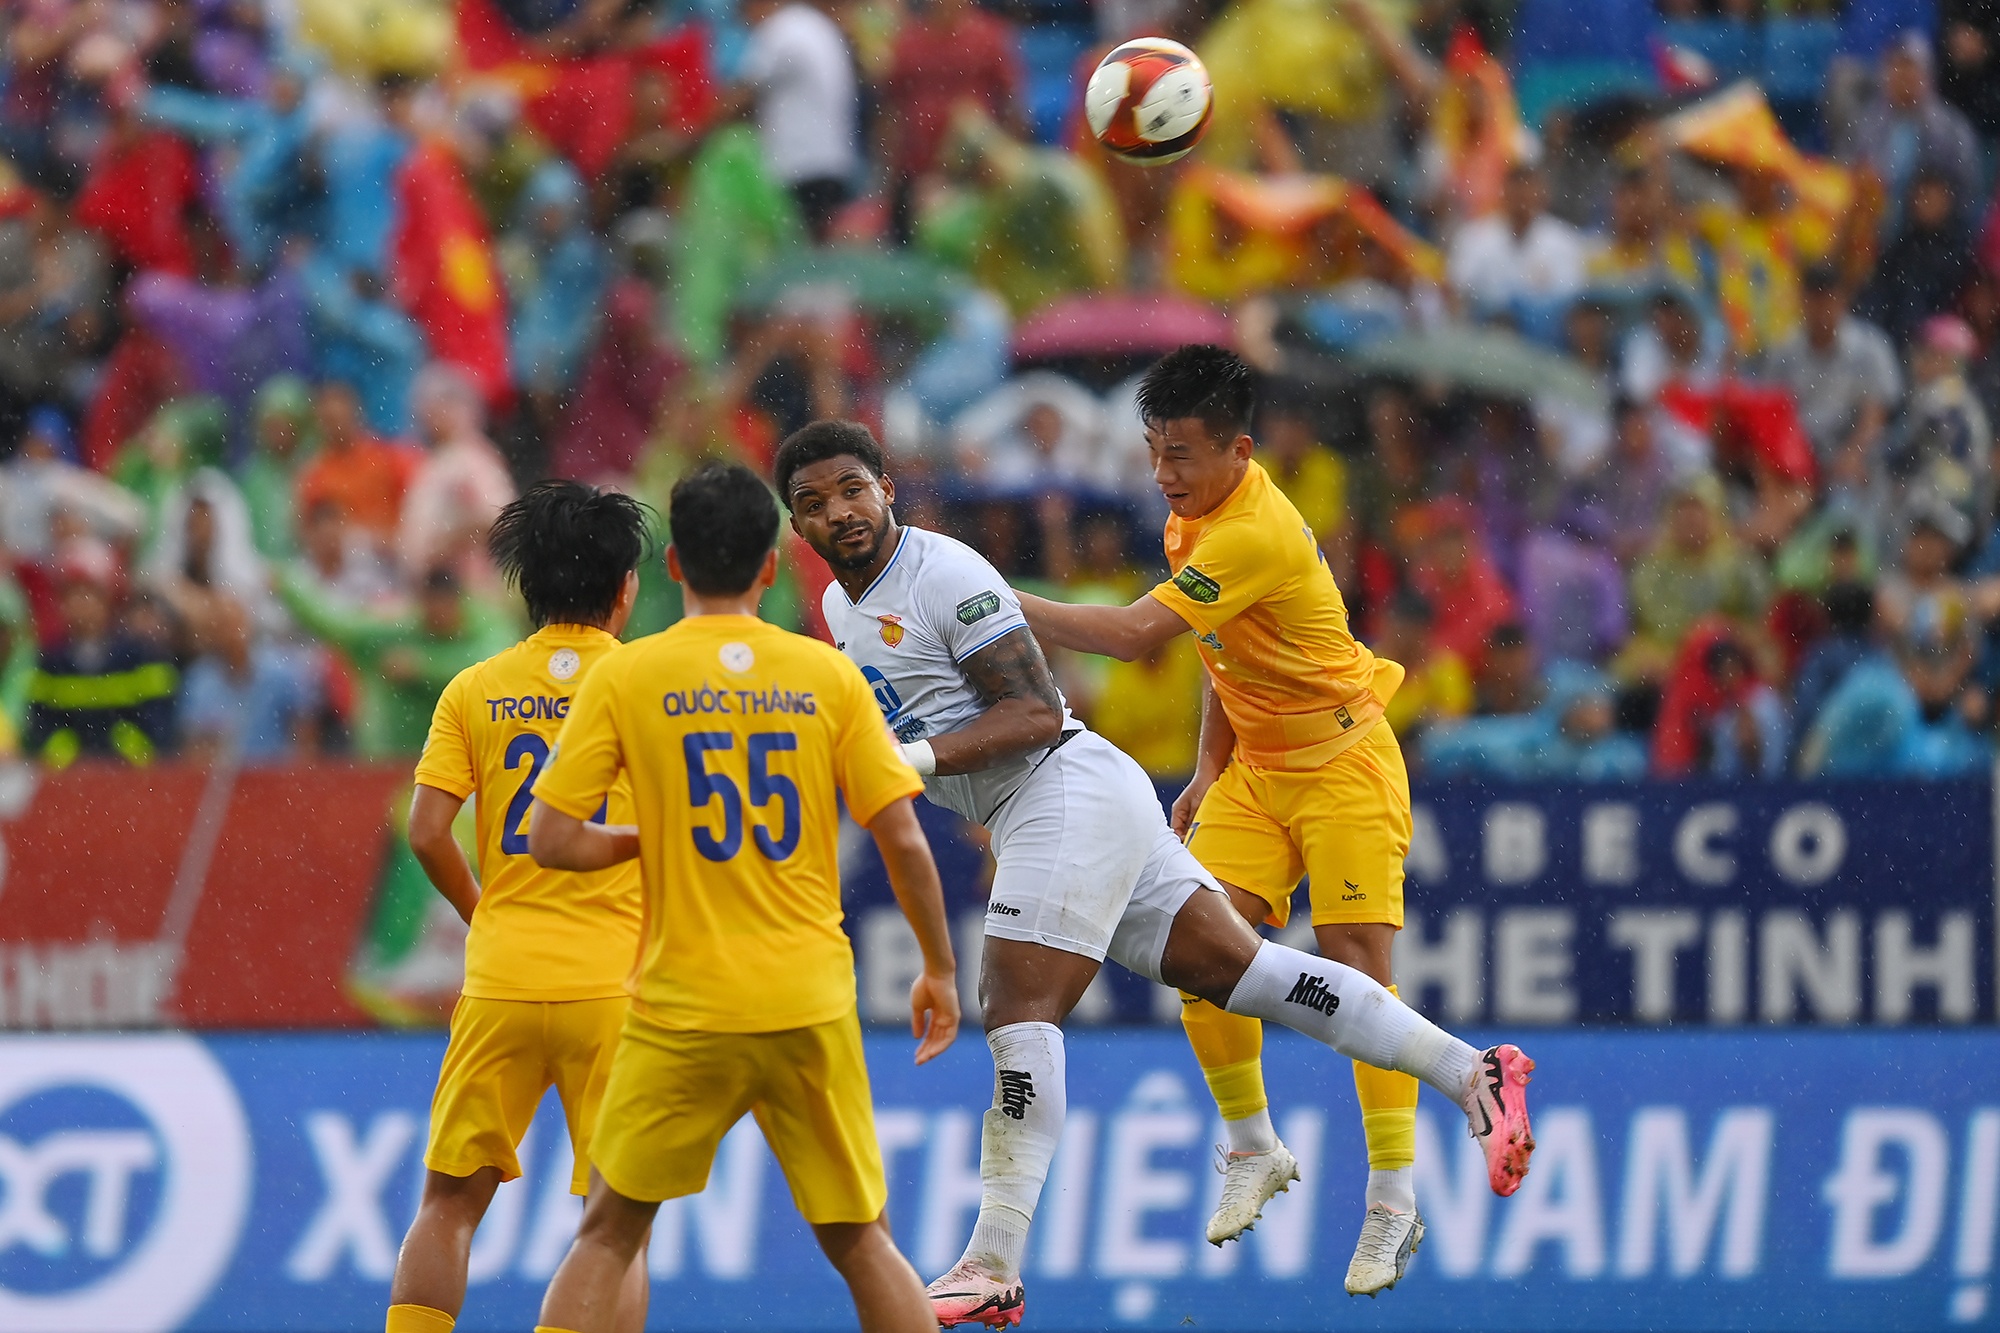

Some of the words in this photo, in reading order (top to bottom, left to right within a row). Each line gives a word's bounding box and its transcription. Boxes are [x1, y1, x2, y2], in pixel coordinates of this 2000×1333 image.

[960, 604, 981, 621] NIGHT
[980, 597, 999, 611] WOLF
[482, 695, 570, 724] TRỌNG
[682, 731, 801, 862] 55
[988, 902, 1021, 917] Mitre
[1608, 910, 1976, 1026] TINH
[1284, 971, 1340, 1017] Mitre
[999, 1069, 1037, 1120] Mitre
[1405, 1108, 1778, 1280] NAM
